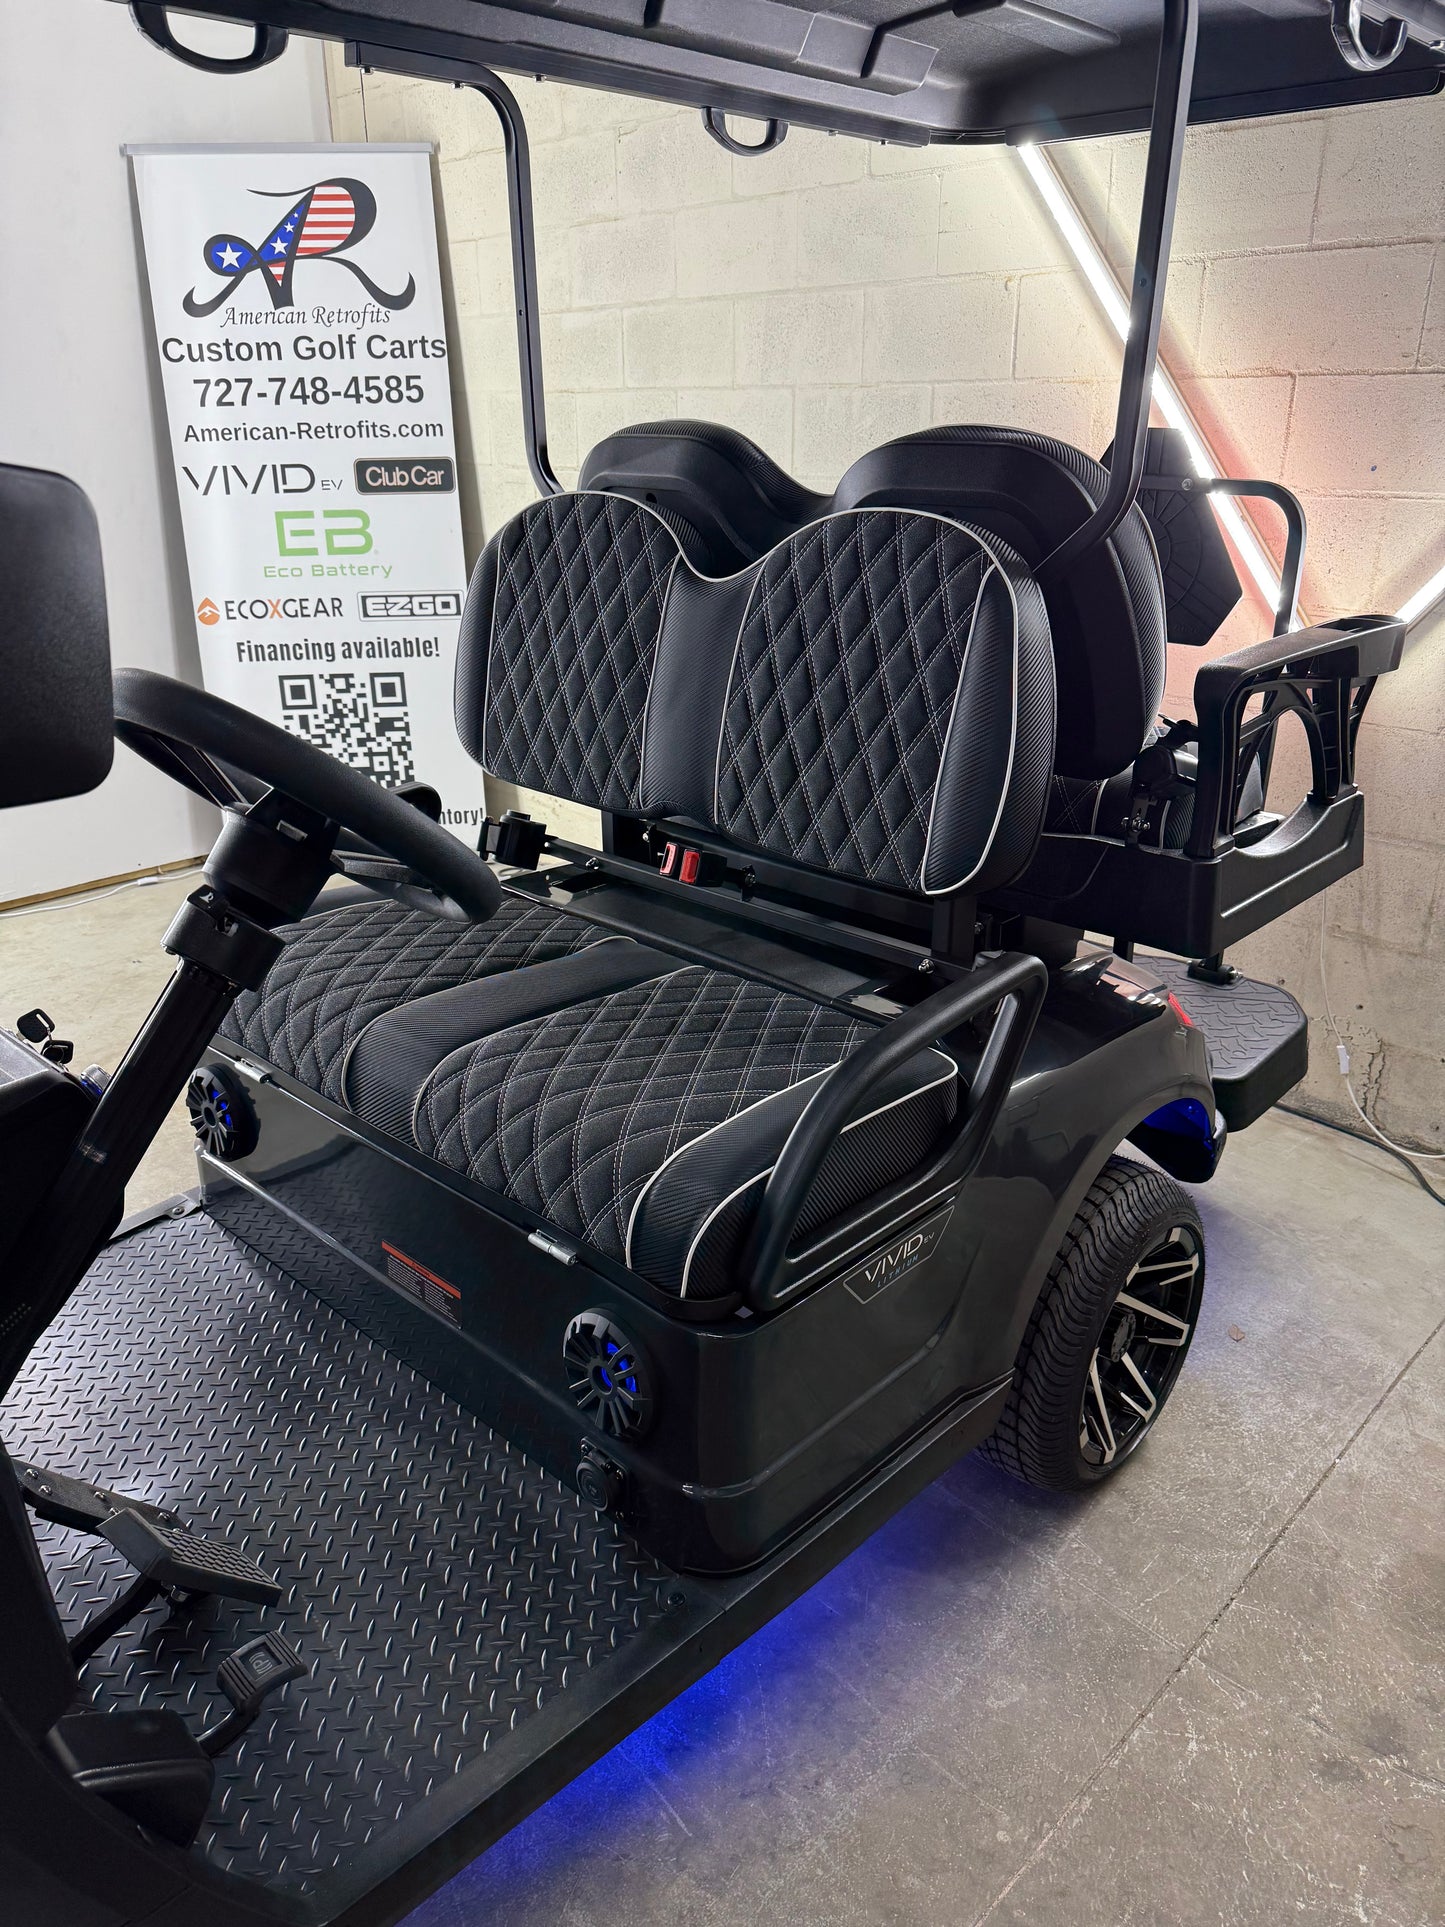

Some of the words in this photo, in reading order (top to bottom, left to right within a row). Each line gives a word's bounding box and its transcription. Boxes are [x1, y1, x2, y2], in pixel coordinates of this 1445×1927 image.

[219, 306, 307, 328] American
[311, 303, 391, 329] Retrofits
[162, 337, 283, 363] Custom
[292, 334, 357, 361] Golf
[366, 334, 447, 360] Carts
[193, 375, 424, 408] 727-748-4585
[184, 421, 444, 443] American-Retrofits.com
[181, 463, 316, 496] VIVID
[321, 479, 343, 491] EV
[365, 466, 410, 487] Club
[410, 465, 445, 486] Car
[274, 508, 374, 557] EB
[264, 566, 303, 578] Eco
[311, 563, 393, 579] Battery
[225, 597, 344, 620] ECOXGEAR
[365, 595, 458, 616] EZGO
[236, 638, 337, 663] Financing
[341, 636, 440, 660] available!
[864, 1233, 924, 1283] VIVID
